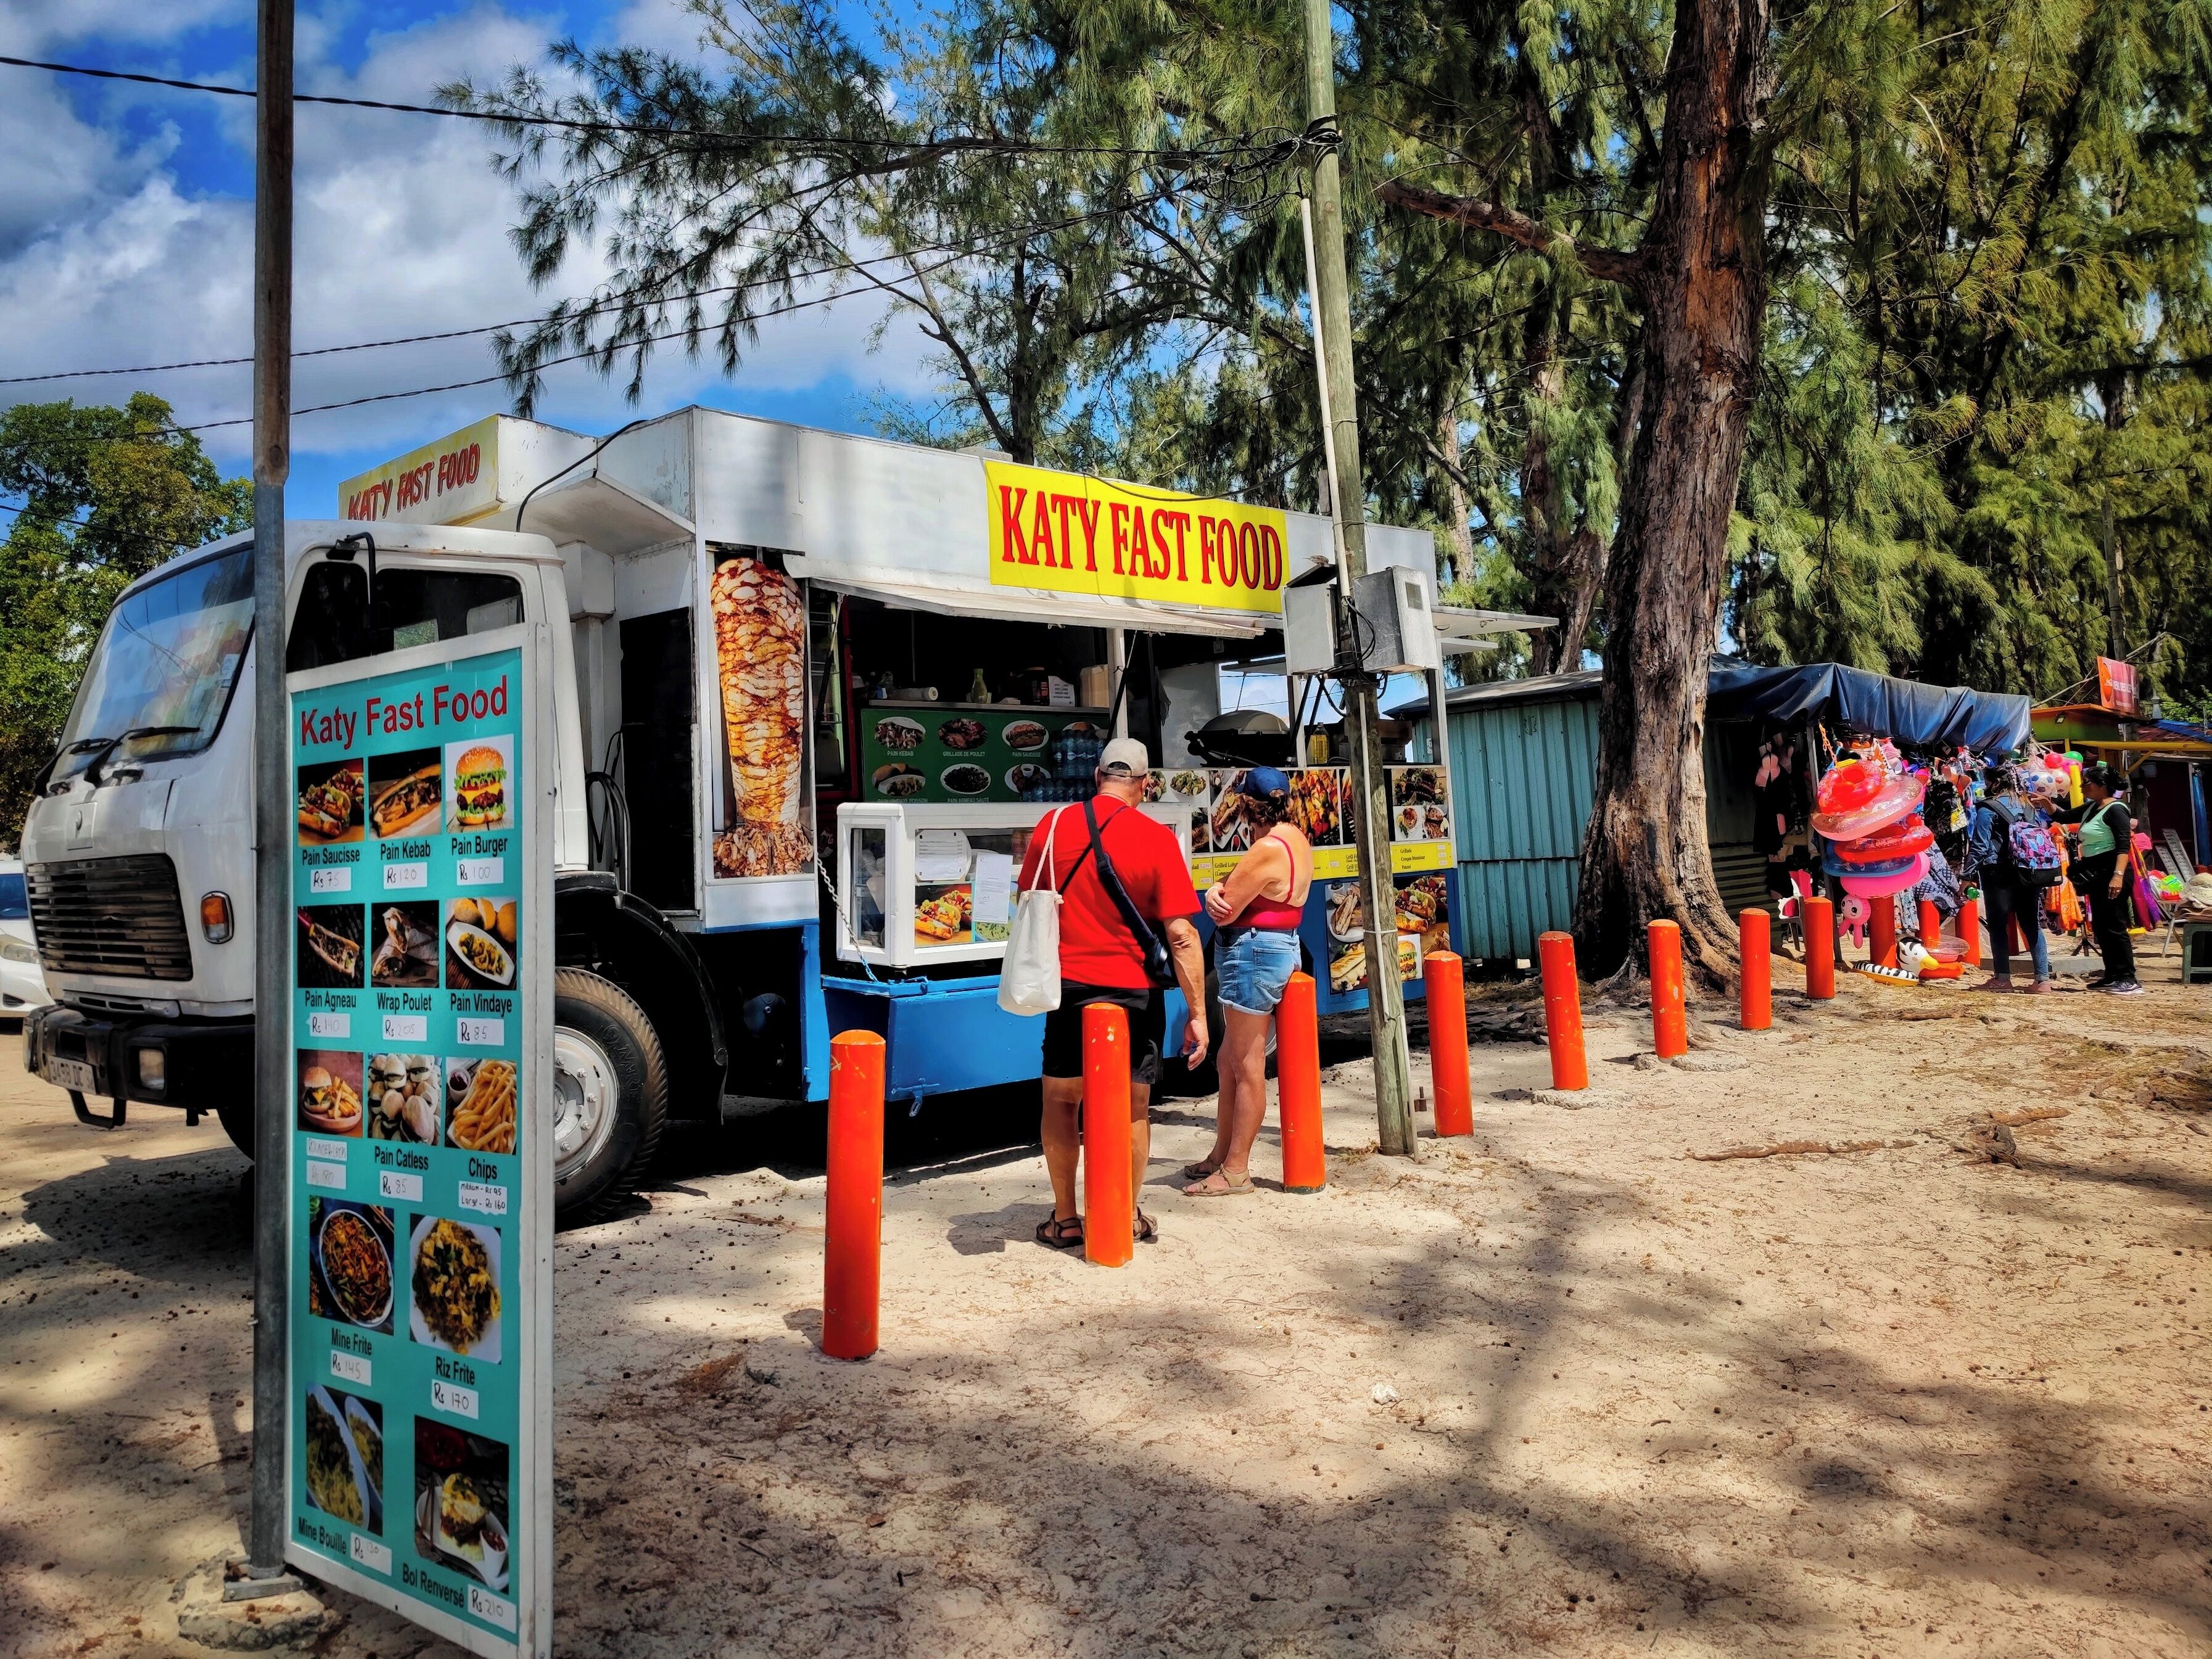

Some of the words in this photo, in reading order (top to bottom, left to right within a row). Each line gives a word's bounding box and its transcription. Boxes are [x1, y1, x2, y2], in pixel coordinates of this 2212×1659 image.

[348, 478, 394, 522] KATY
[397, 461, 435, 513] FAST
[437, 442, 481, 497] FOOD
[999, 485, 1101, 572] KATY
[1109, 502, 1191, 582] FAST
[1197, 515, 1282, 591] FOOD
[301, 706, 357, 750] Katy
[366, 691, 424, 736] Fast
[434, 675, 508, 726] Food
[302, 849, 320, 866] Pain
[322, 847, 360, 865] Saucisse
[381, 842, 400, 860] Pain
[402, 839, 431, 858] Kebab
[452, 838, 473, 855] Pain
[475, 836, 508, 857] Burger
[313, 870, 324, 888] Rs
[387, 868, 396, 883] Rs
[460, 864, 468, 880] Rs
[305, 991, 323, 1008] Pain
[324, 992, 357, 1012] Agneau
[377, 992, 400, 1015] Wrap
[402, 992, 432, 1011] Poulet
[450, 993, 471, 1011] Pain
[473, 993, 512, 1017] Vindaye
[312, 1016, 321, 1033] Rs
[385, 1019, 394, 1037] Rs
[461, 1021, 470, 1042] Rs
[374, 1145, 393, 1166] Pain
[395, 1147, 429, 1171] Catless
[469, 1157, 497, 1184] Chips
[382, 1175, 392, 1194] Rs
[331, 1327, 351, 1349] Mine
[353, 1333, 372, 1356] Frite
[332, 1354, 341, 1372] Rs
[435, 1356, 451, 1378] Riz
[453, 1360, 476, 1385] Frite
[434, 1382, 444, 1404] Rs
[452, 1392, 469, 1410] 170
[299, 1517, 317, 1542] Mine
[319, 1526, 347, 1555] Bouille
[403, 1563, 418, 1588] Bol
